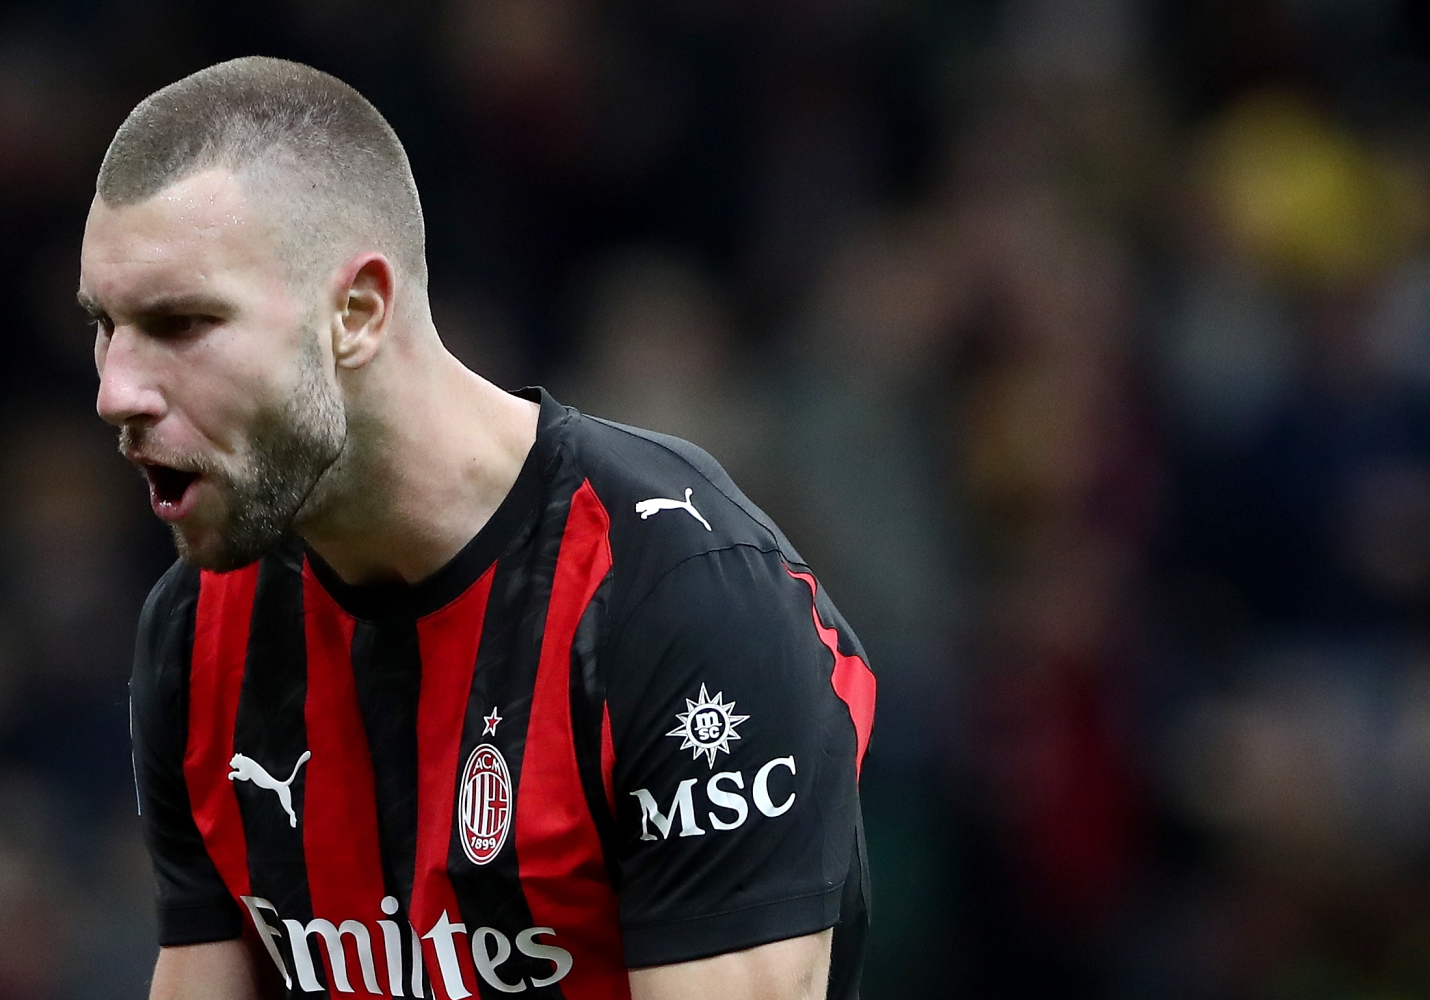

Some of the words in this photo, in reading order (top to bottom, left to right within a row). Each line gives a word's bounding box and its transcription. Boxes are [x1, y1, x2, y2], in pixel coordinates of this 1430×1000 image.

[473, 753, 502, 777] ACM
[629, 755, 797, 841] MSC
[470, 836, 497, 850] 1899
